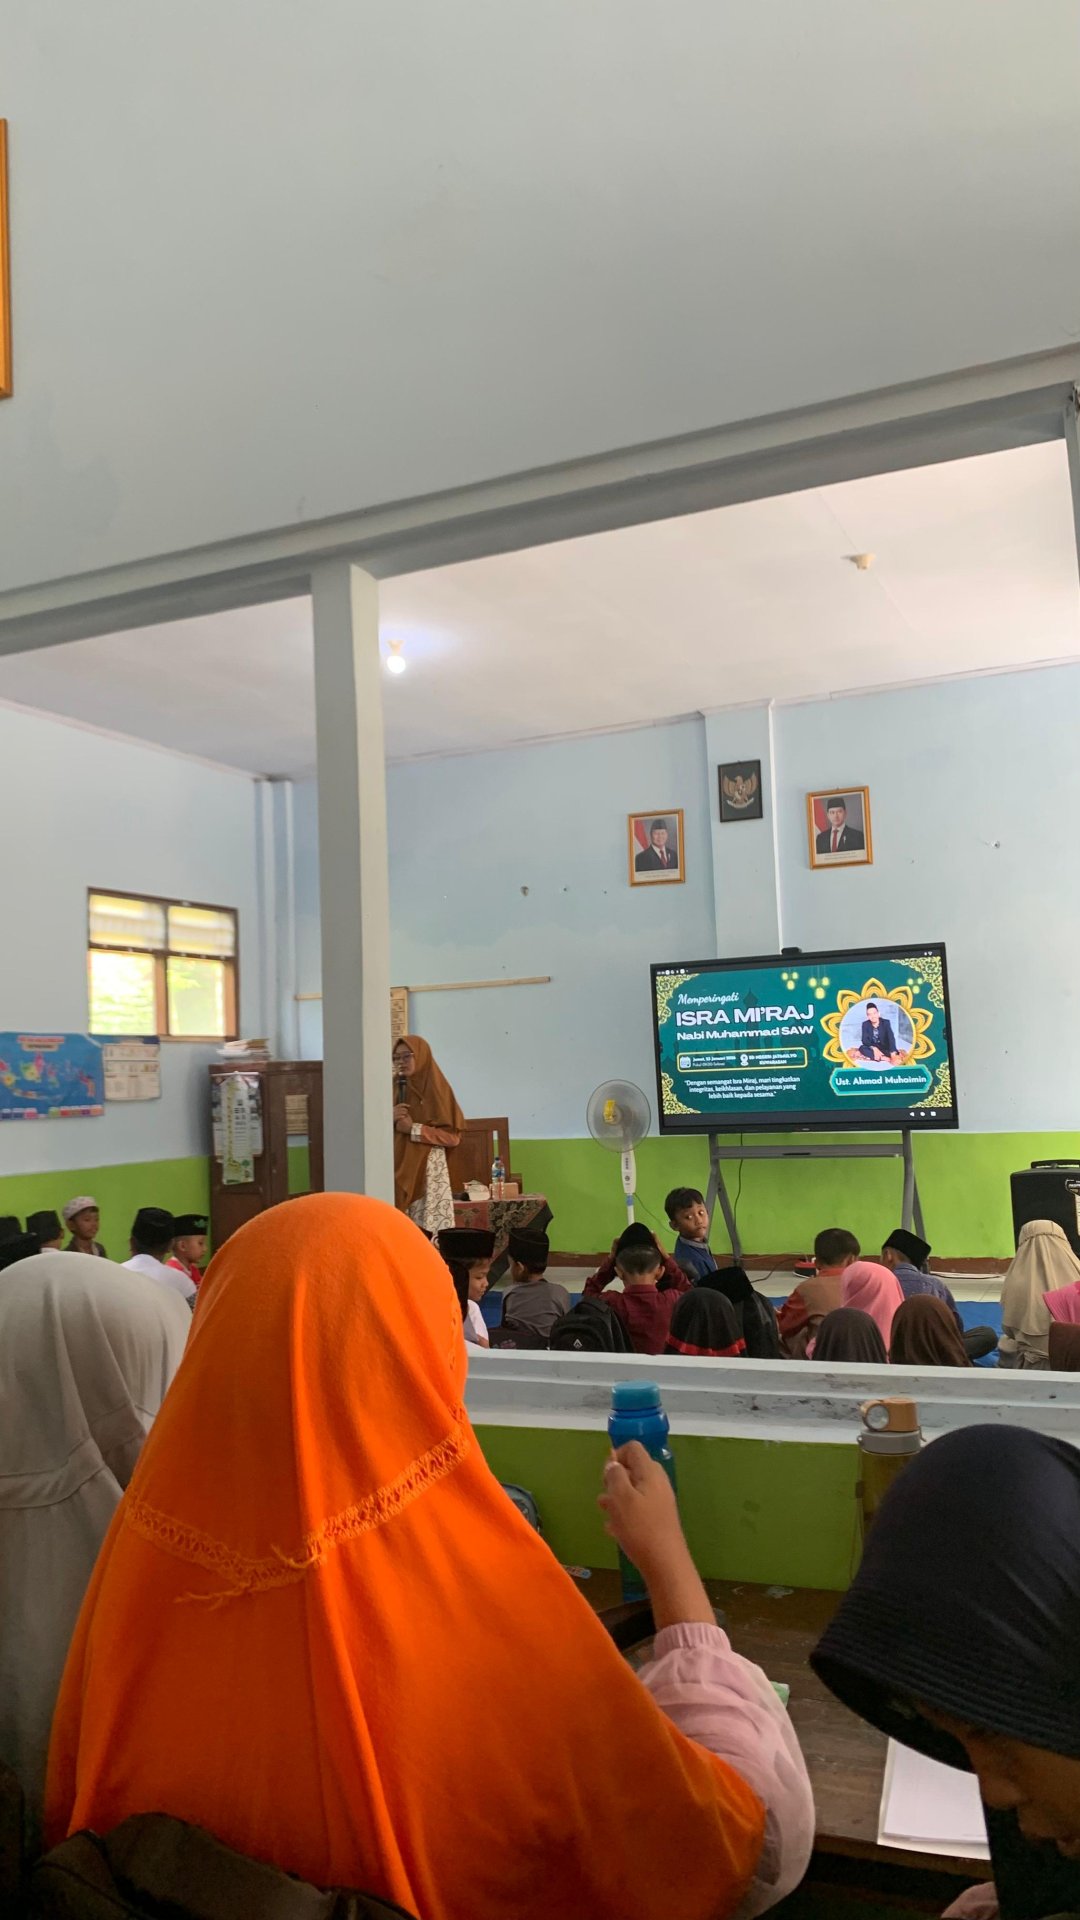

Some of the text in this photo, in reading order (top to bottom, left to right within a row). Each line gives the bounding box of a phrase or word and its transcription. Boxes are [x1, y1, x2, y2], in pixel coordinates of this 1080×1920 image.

[677, 992, 740, 1006] Memperingati
[676, 1004, 814, 1026] ISRA MI'RAJ
[677, 1026, 814, 1041] Nabi Muhammad SAW
[707, 1078, 732, 1086] semangat
[835, 1075, 926, 1086] Ust. Ahmad Muhaimin
